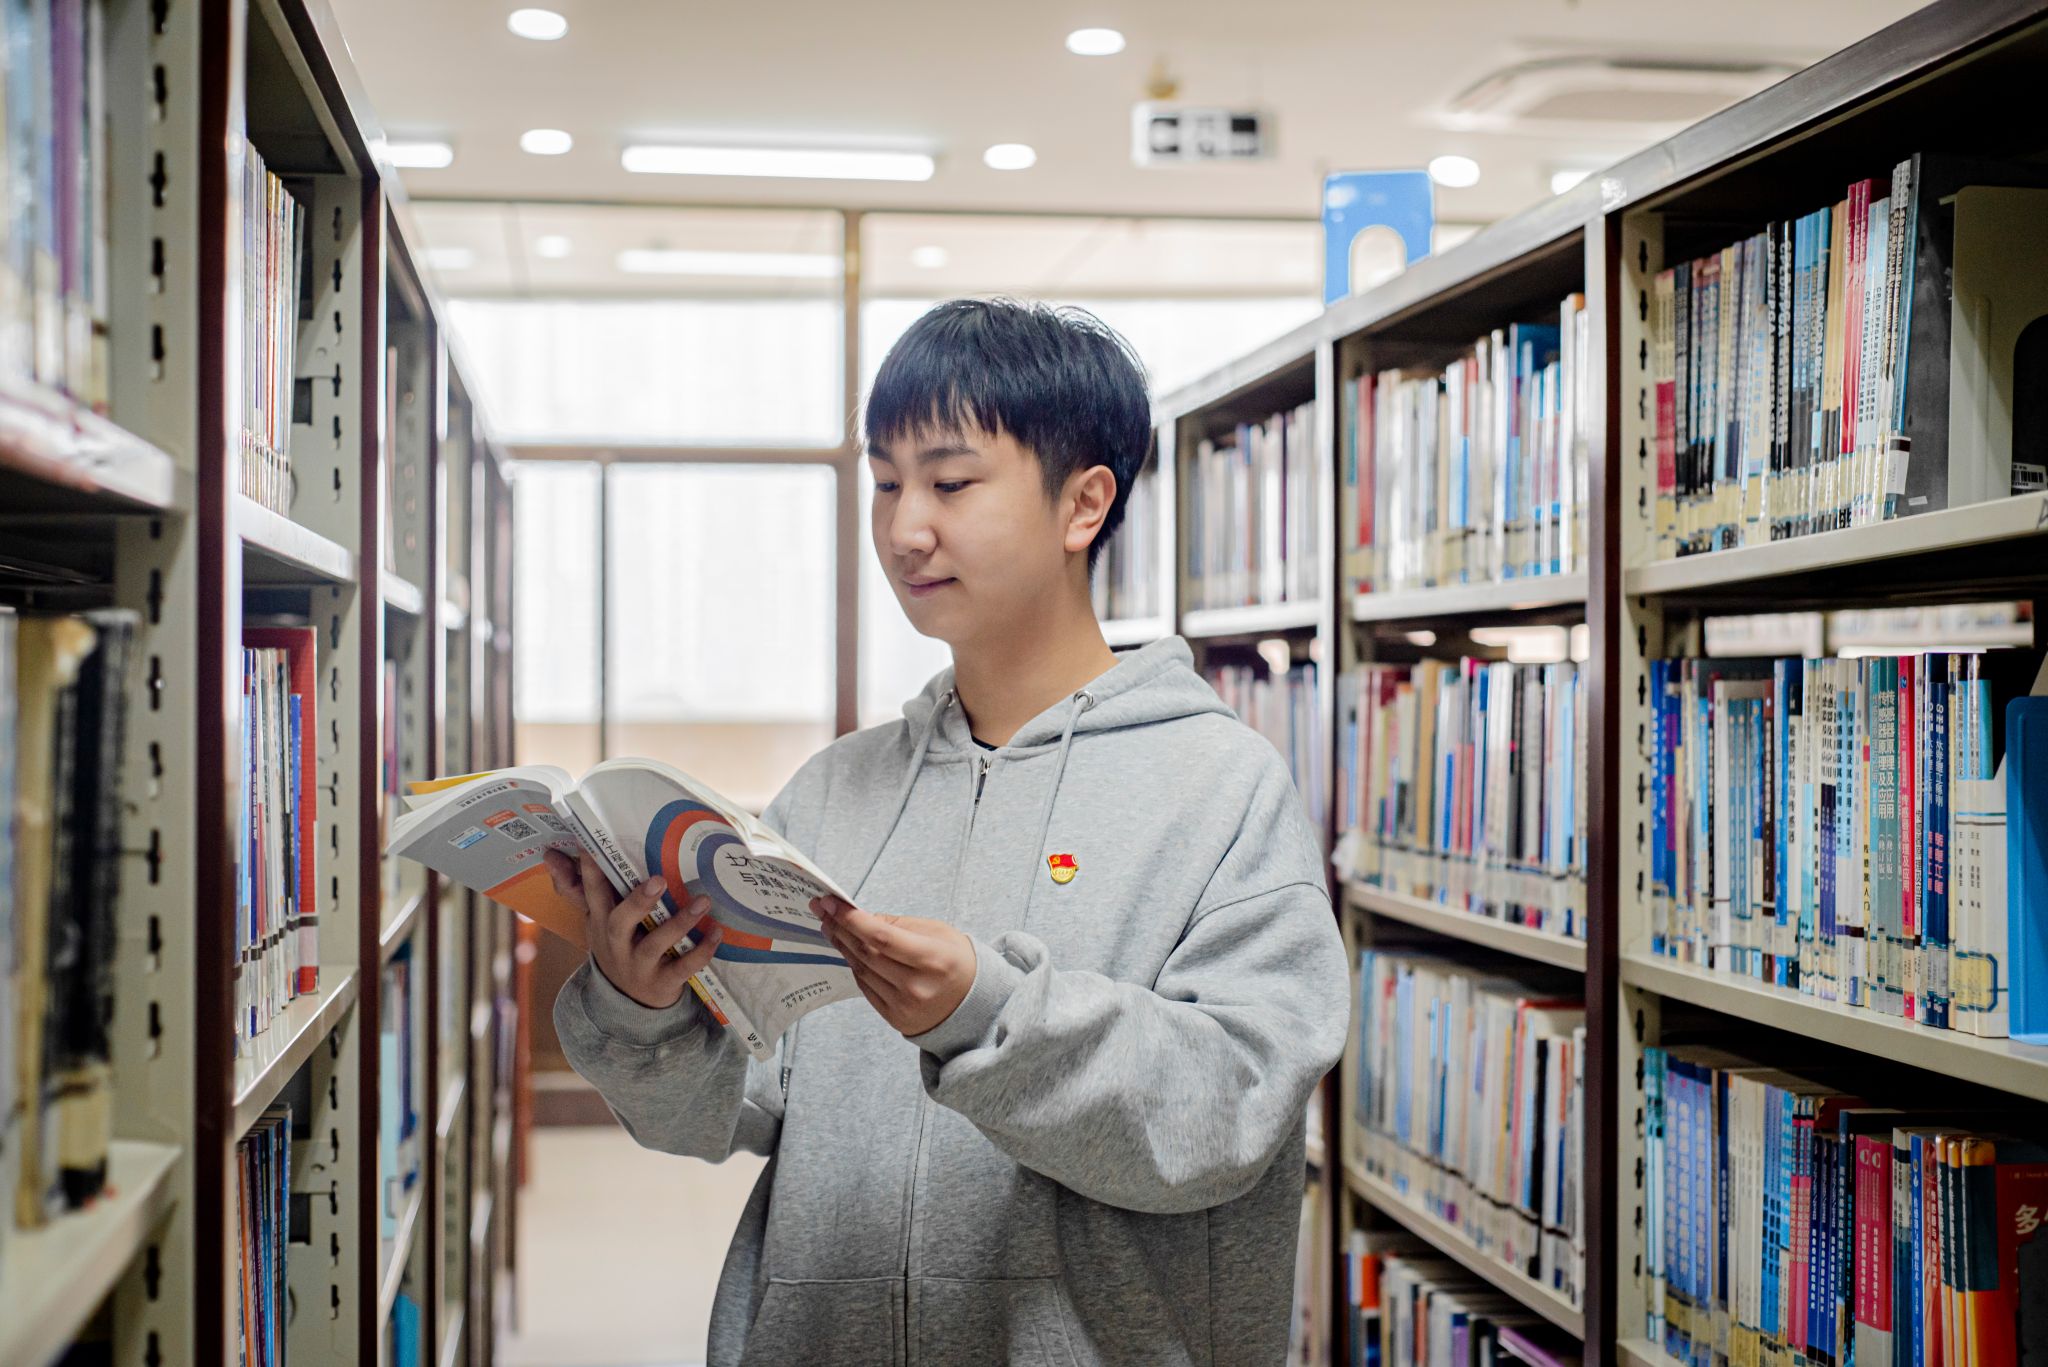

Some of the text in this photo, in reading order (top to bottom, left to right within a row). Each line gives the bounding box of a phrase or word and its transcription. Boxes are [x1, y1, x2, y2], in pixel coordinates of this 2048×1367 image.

[1879, 691, 1887, 819] 传感器原理及应用
[1887, 690, 1895, 819] 传感器原理及应用
